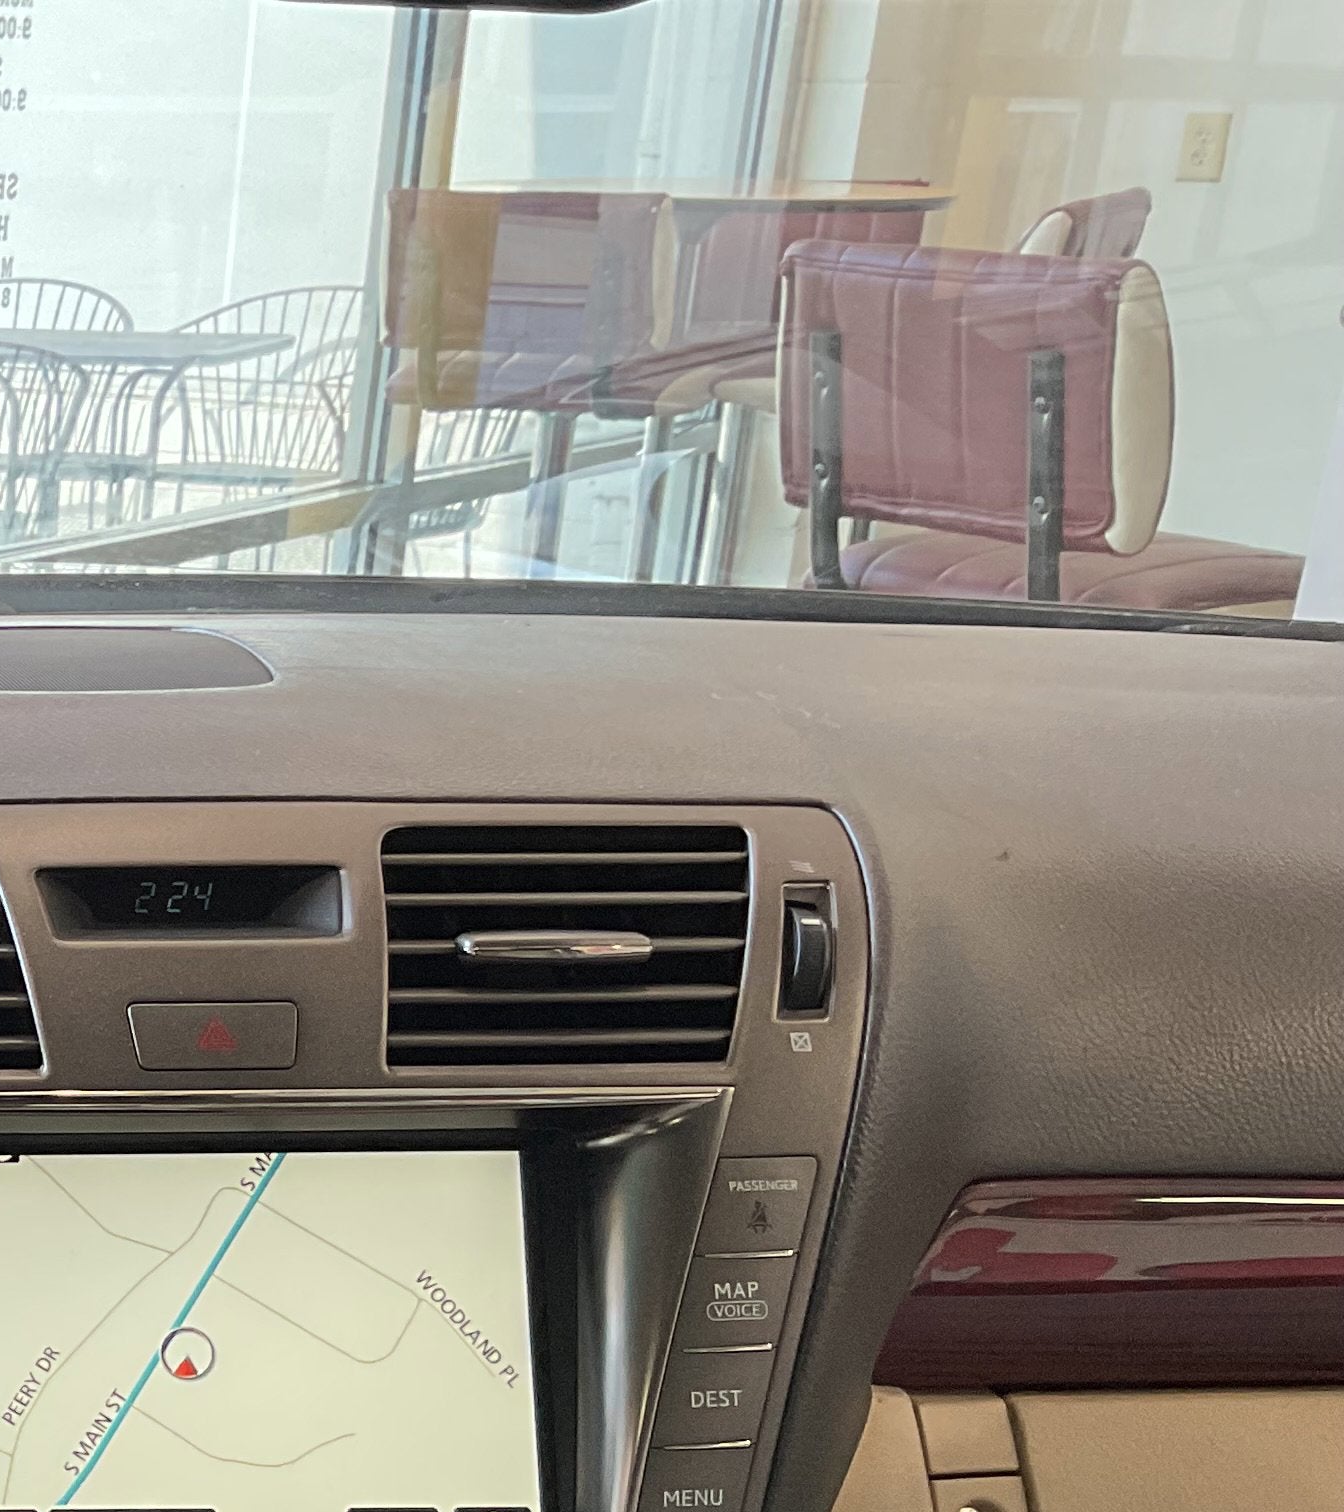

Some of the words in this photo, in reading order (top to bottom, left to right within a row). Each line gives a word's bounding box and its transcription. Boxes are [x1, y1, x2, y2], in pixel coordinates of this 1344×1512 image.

[728, 1180, 799, 1192] PASSENGER
[713, 1281, 760, 1300] MAP
[713, 1304, 761, 1318] VOICE
[415, 1269, 502, 1365] WOODLAND
[498, 1364, 520, 1389] PL
[1, 1371, 42, 1426] PEERY
[34, 1346, 61, 1373] DR
[690, 1389, 743, 1409] DEST
[64, 1461, 80, 1476] S
[72, 1412, 114, 1463] MAIN
[104, 1388, 128, 1414] ST
[663, 1489, 724, 1508] MENU
